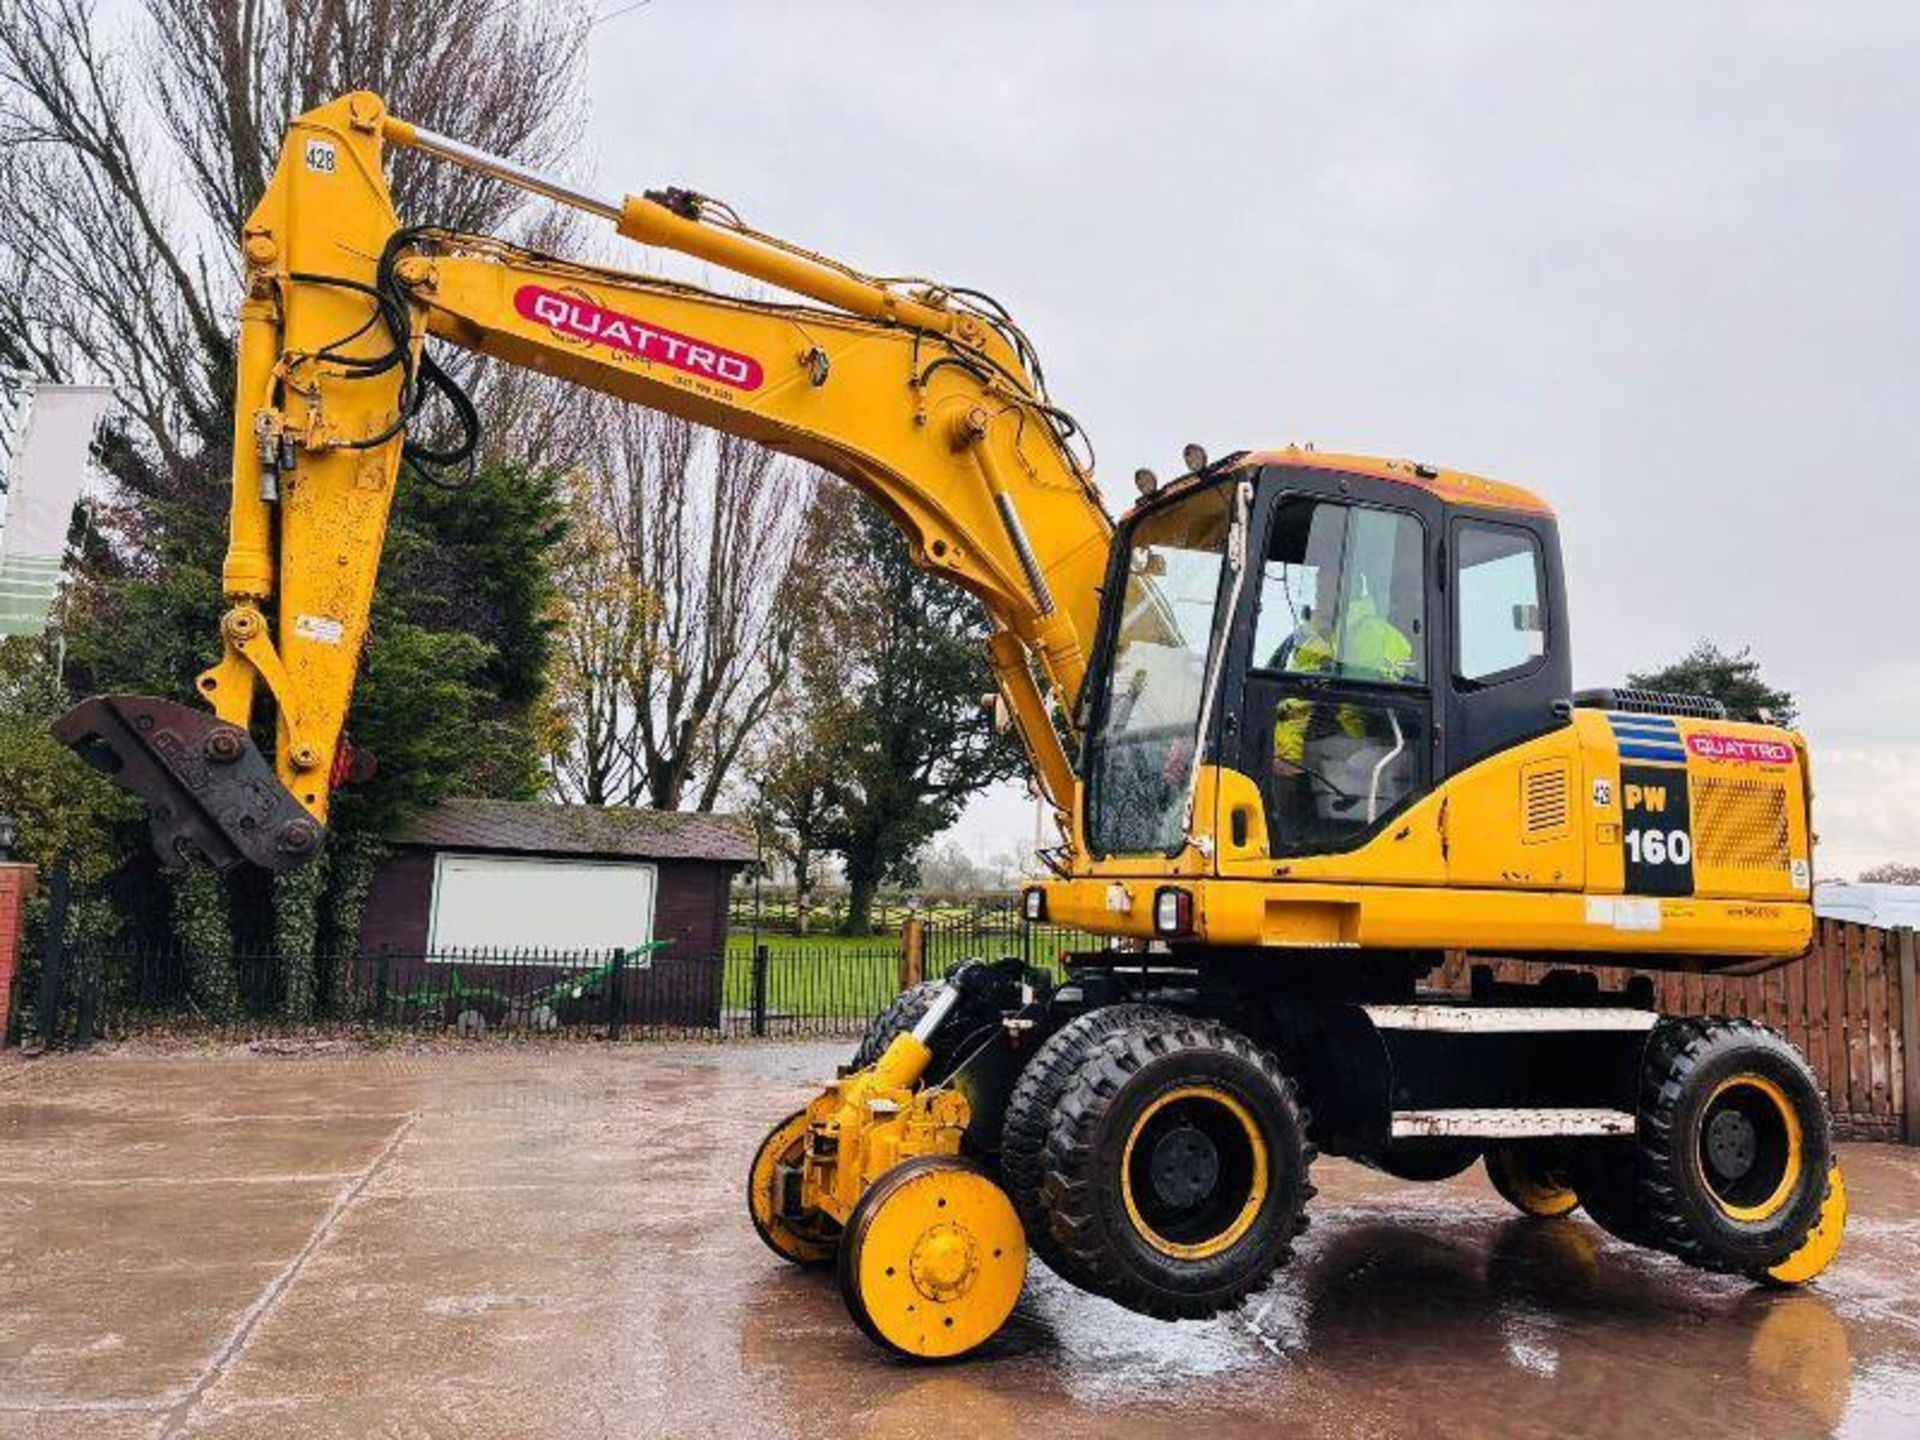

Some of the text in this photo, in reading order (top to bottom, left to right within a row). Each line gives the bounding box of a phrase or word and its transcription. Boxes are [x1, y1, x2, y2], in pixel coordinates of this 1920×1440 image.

[306, 148, 334, 171] 428
[534, 294, 749, 383] QUATTRO
[1694, 738, 1787, 760] QUATTRO
[1624, 784, 1667, 812] PW
[1624, 829, 1691, 866] 160
